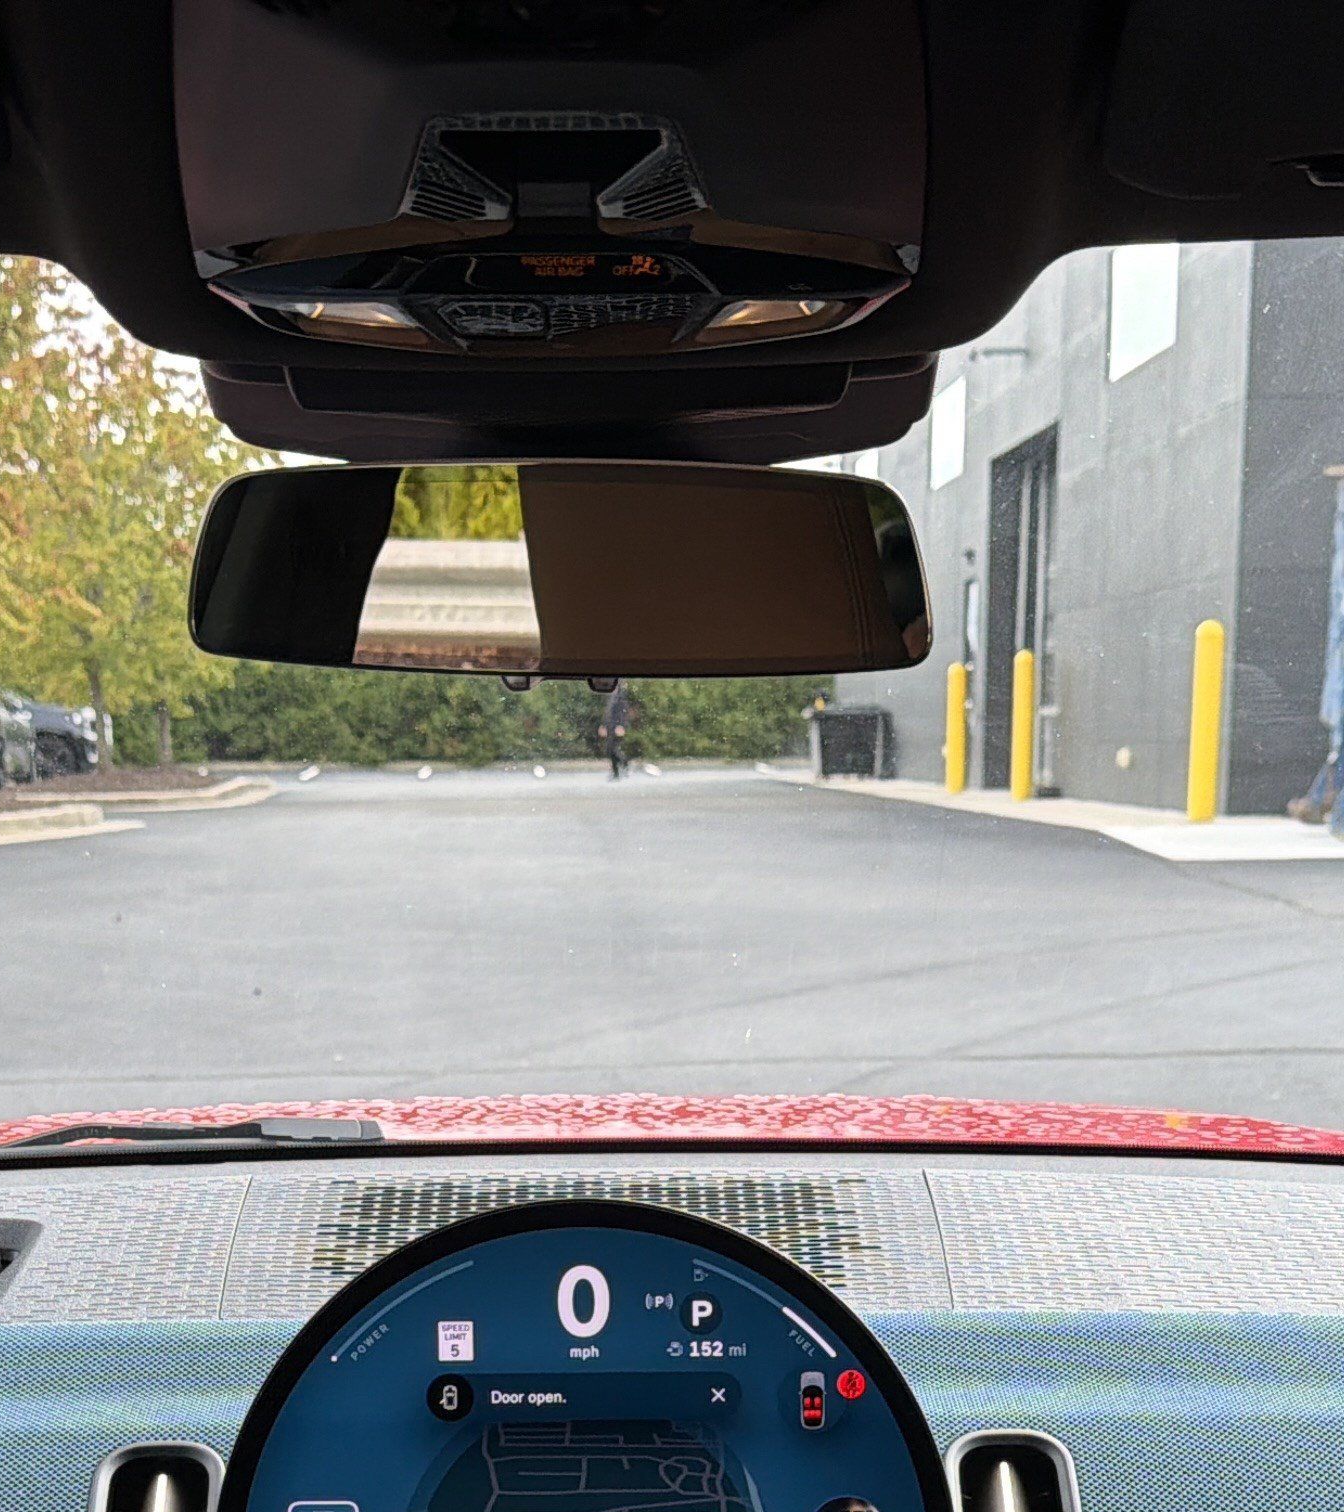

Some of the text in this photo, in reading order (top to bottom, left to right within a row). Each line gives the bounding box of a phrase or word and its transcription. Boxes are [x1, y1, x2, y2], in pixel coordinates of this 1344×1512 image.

[520, 255, 595, 266] PASSENGER
[534, 266, 584, 277] AIR BAG
[557, 1265, 610, 1338] 0
[692, 1300, 713, 1326] P
[441, 1324, 470, 1332] SPEED
[350, 1323, 390, 1362] POWER
[444, 1333, 467, 1341] LIMIT
[789, 1330, 817, 1357] FUEL
[450, 1344, 460, 1358] 5
[569, 1346, 600, 1360] mph
[689, 1341, 747, 1357] 152 mi
[491, 1391, 567, 1407] Door open.
